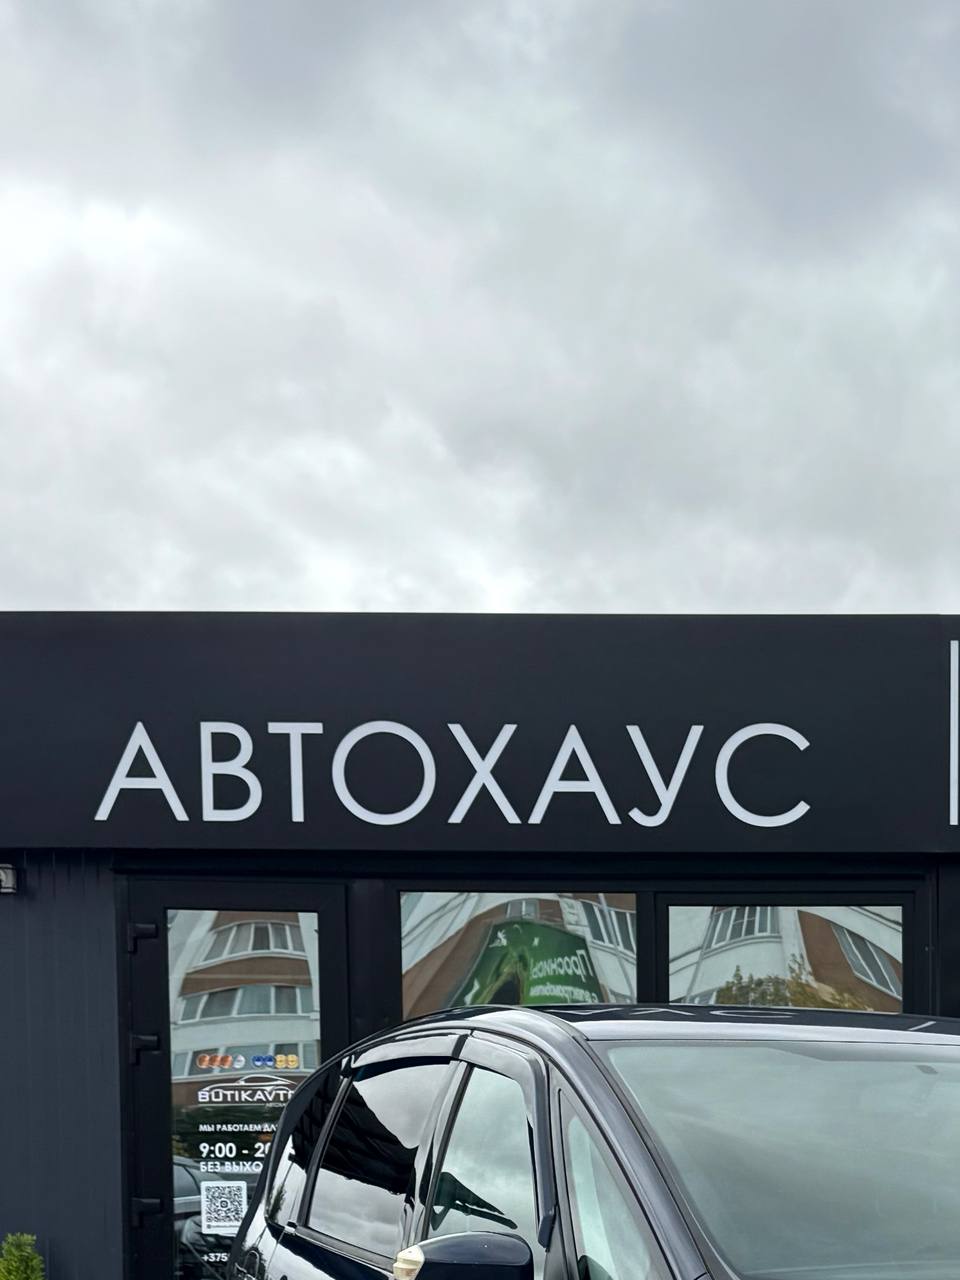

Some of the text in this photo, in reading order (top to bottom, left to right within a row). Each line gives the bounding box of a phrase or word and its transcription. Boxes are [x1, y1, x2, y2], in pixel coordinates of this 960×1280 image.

[94, 720, 811, 828] АВТОХАУС
[198, 1090, 294, 1102] BUTIKAVT
[199, 1123, 278, 1132] МЫ РАБОТАЕМ ДЛ
[199, 1142, 236, 1158] 9:00
[199, 1161, 221, 1173] БЕЗ
[202, 1253, 231, 1262] +375
